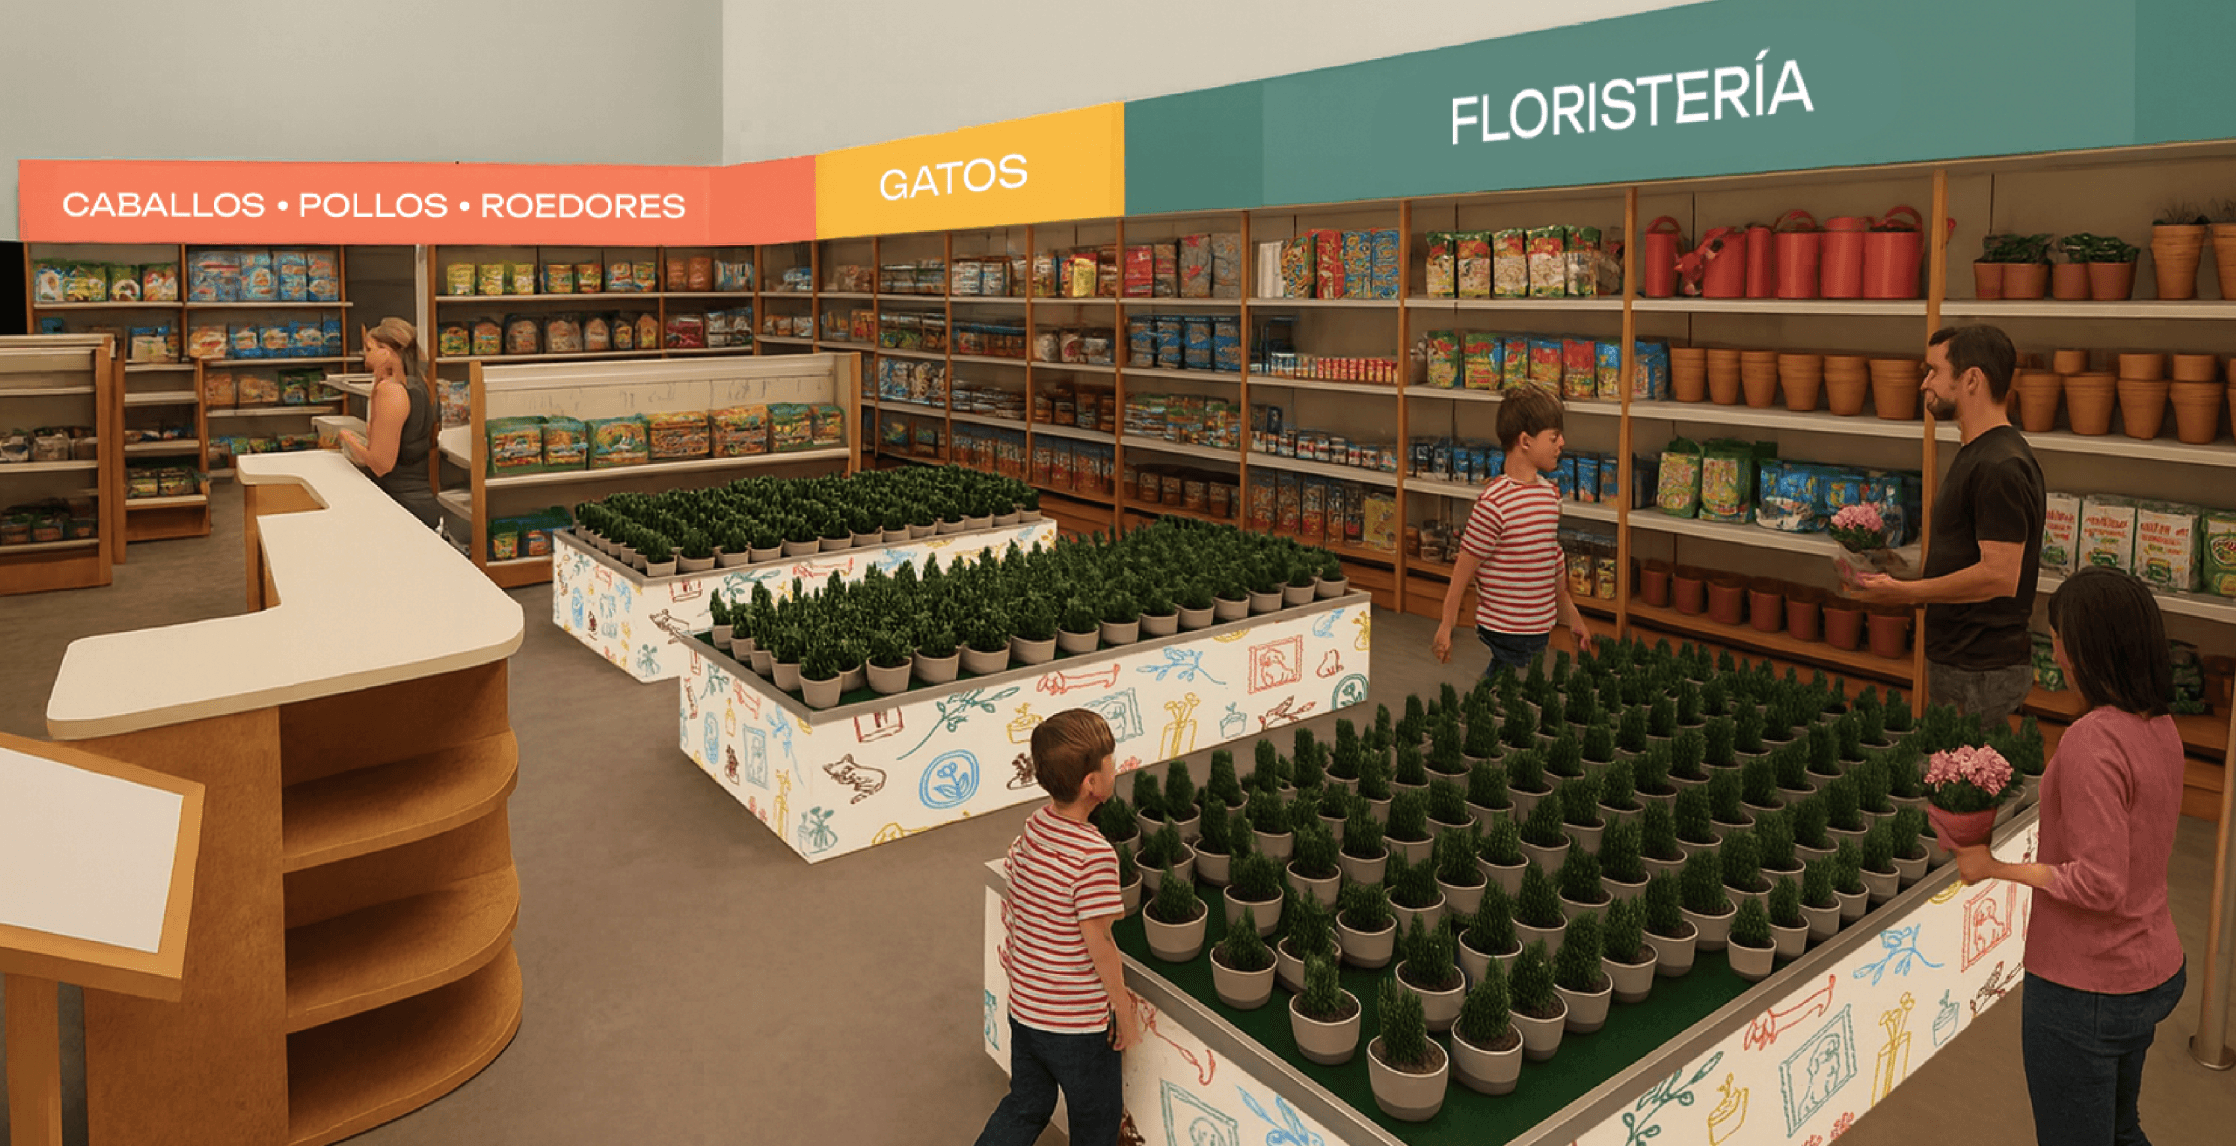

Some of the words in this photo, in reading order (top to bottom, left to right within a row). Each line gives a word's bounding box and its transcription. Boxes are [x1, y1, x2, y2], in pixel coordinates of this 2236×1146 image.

[1451, 48, 1815, 146] FLORISTERÍA
[879, 153, 1029, 202] GATOS
[62, 192, 266, 219] CABALLOS
[299, 192, 449, 219] POLLOS
[481, 193, 687, 220] ROEDORES
